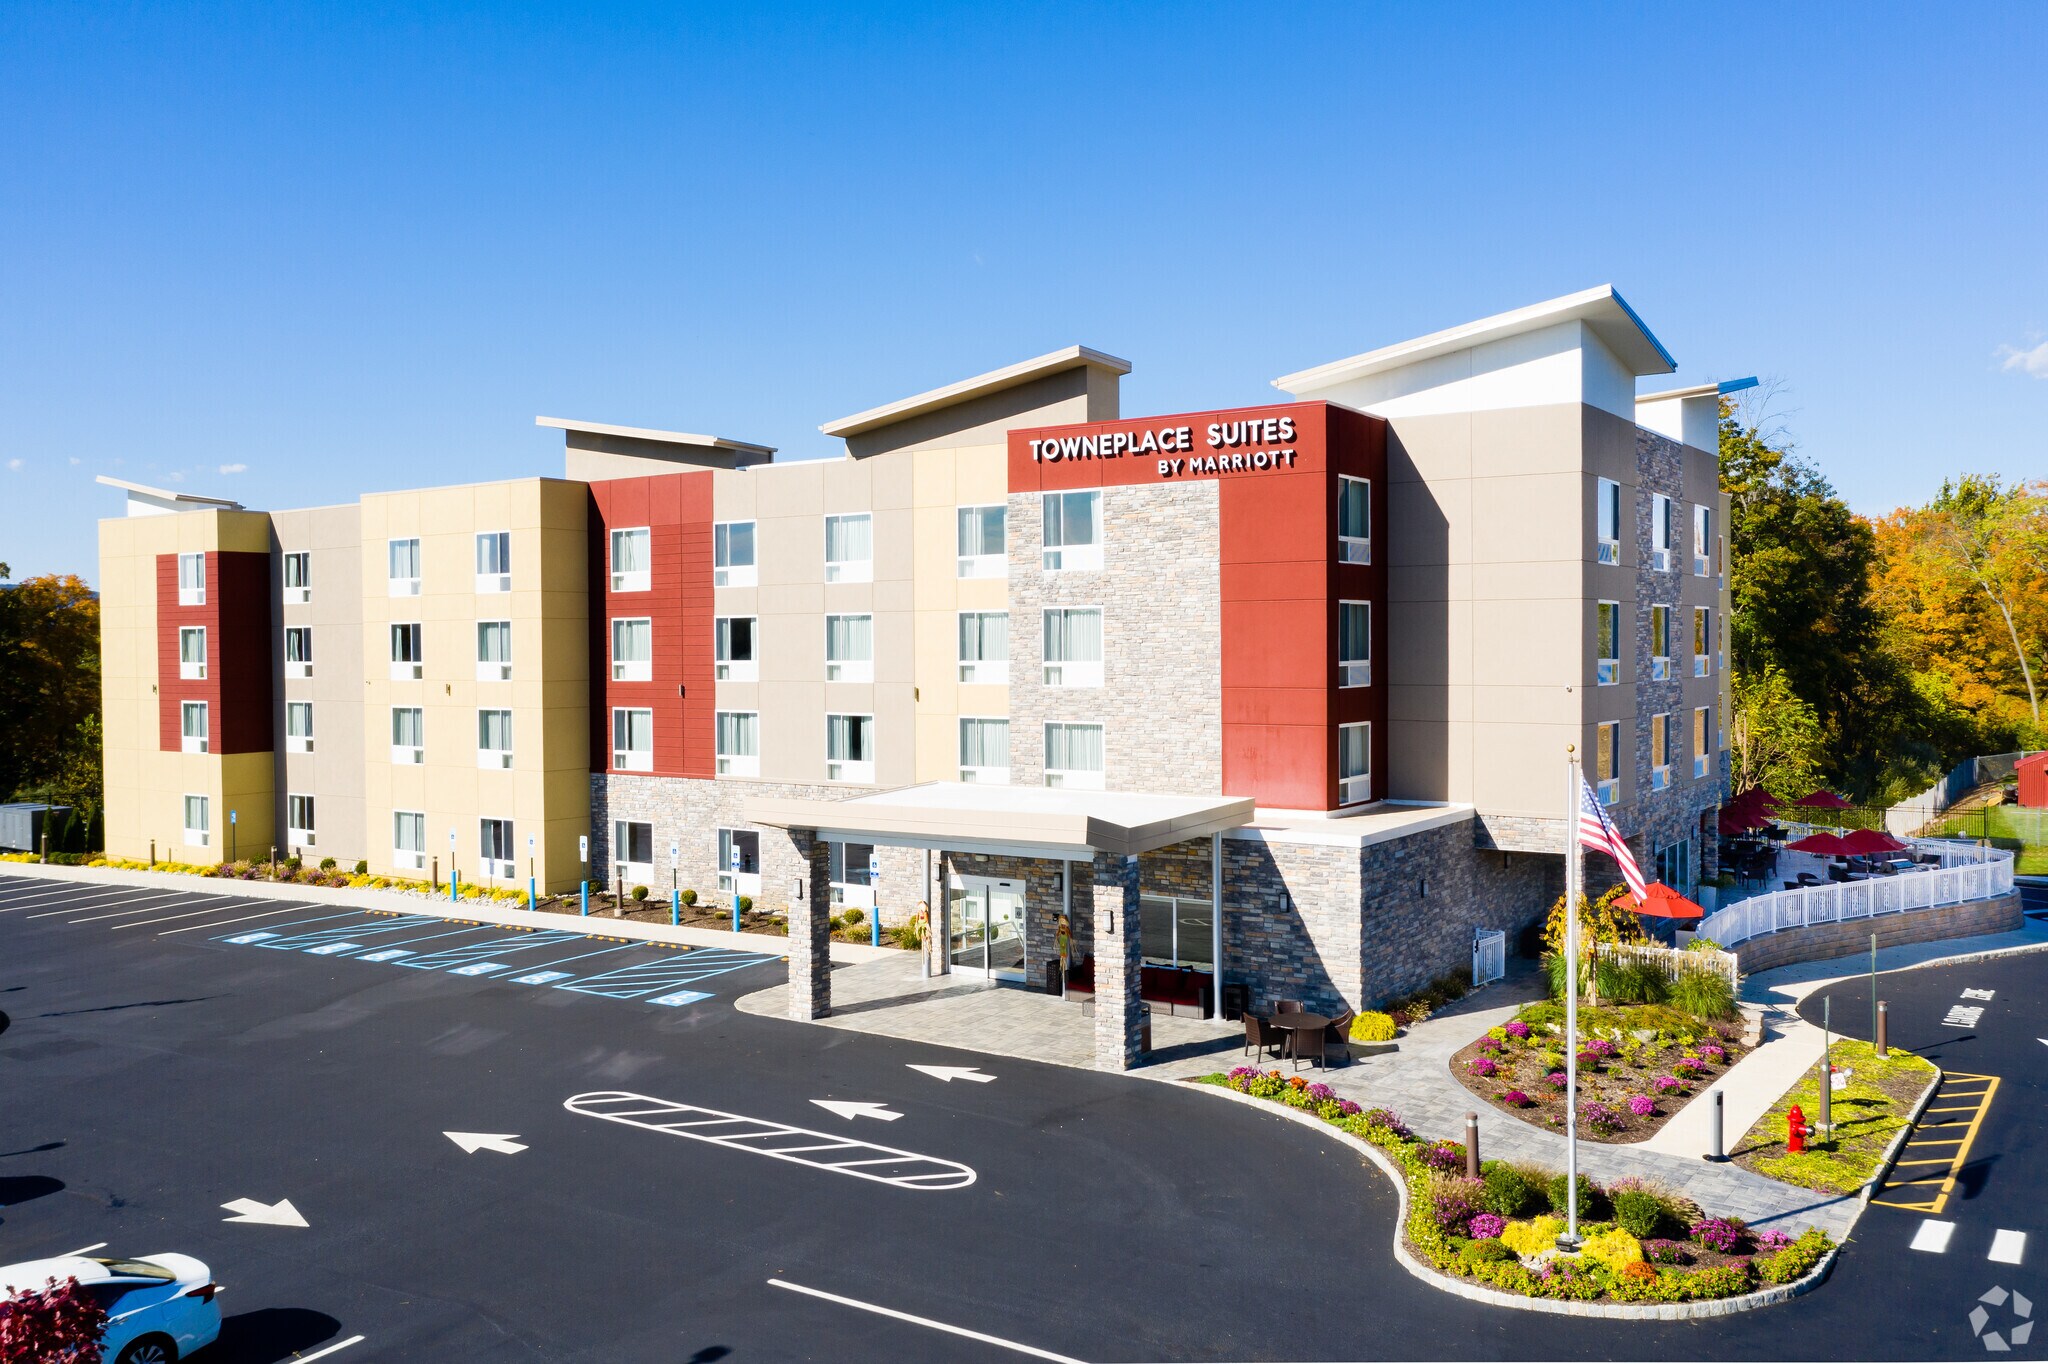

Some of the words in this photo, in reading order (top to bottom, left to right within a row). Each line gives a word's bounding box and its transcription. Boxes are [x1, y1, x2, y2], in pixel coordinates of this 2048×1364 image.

[1029, 426, 1191, 461] TOWNEPLACE
[1206, 416, 1295, 447] SUITES
[1157, 458, 1182, 475] BY
[1189, 449, 1295, 472] MARRIOTT
